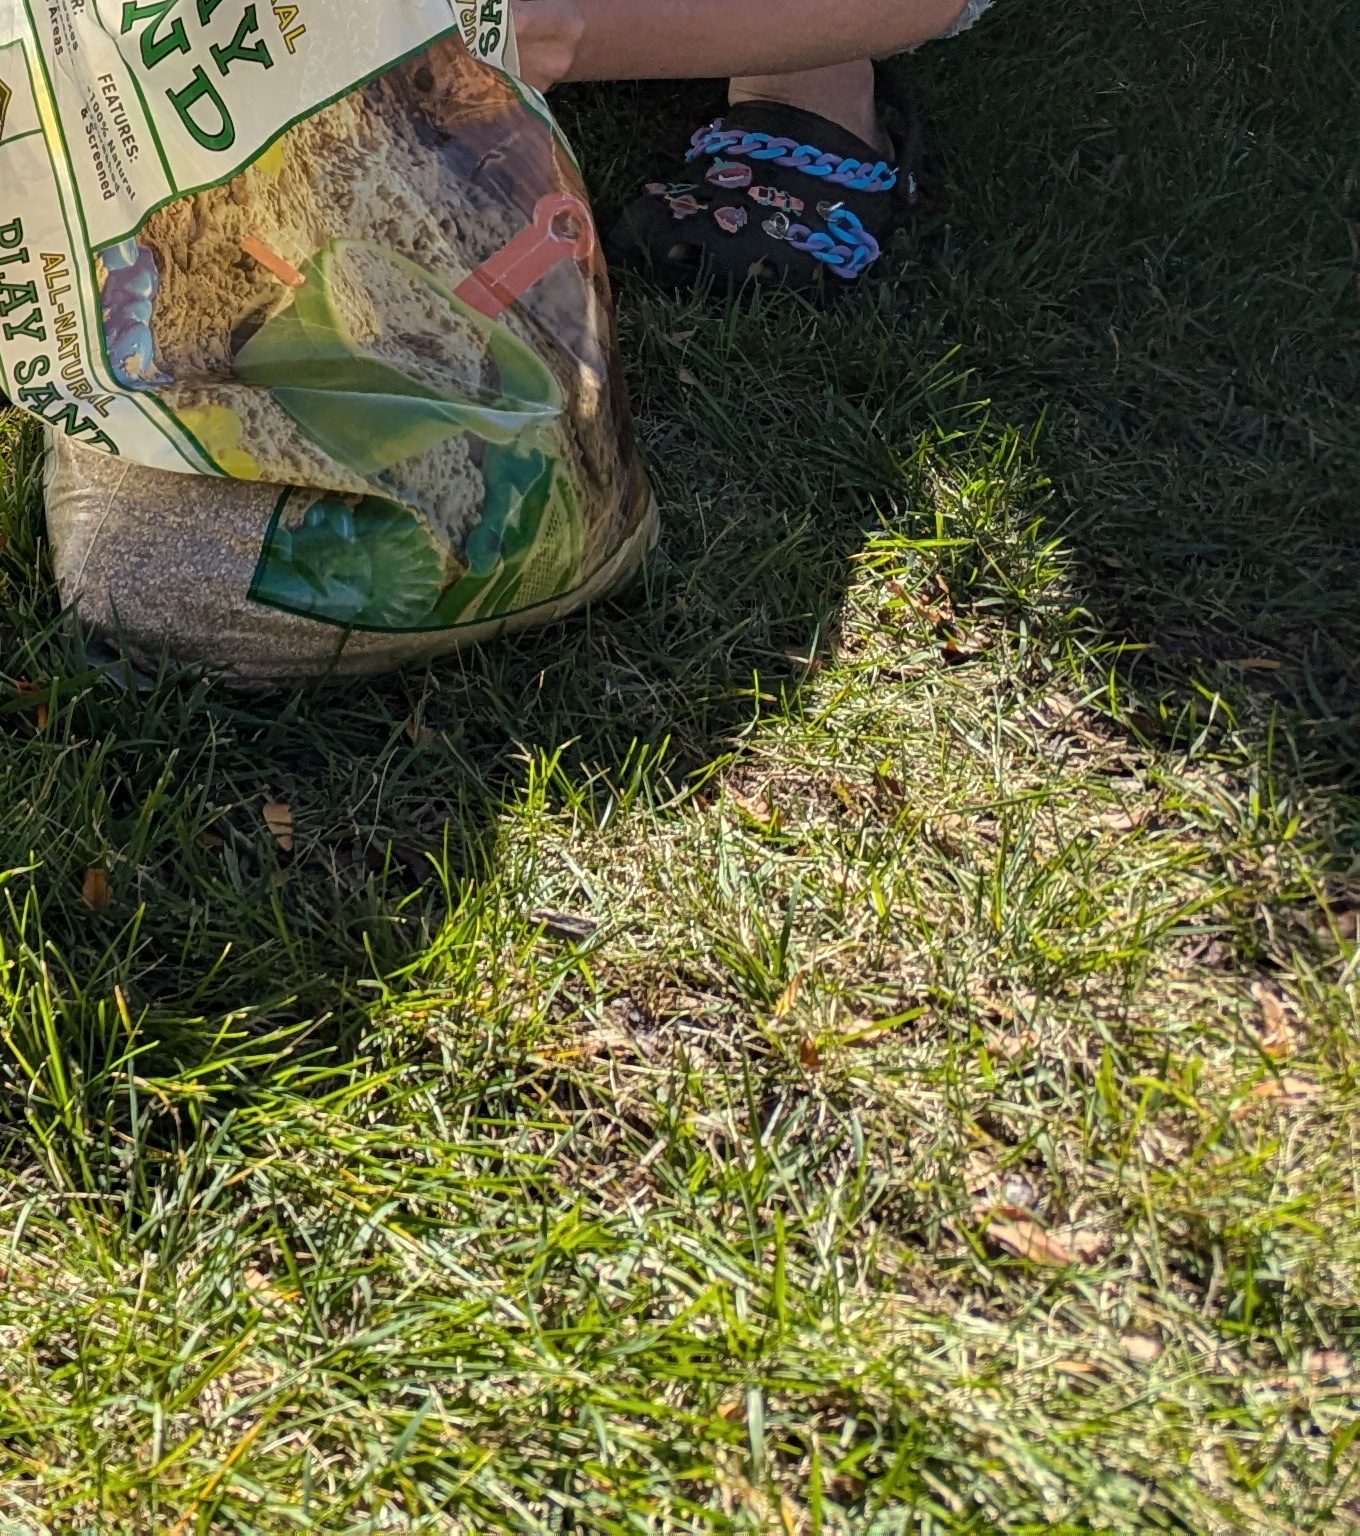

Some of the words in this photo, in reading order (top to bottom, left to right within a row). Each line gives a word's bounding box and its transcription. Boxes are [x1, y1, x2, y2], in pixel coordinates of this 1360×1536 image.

[48, 6, 64, 56] Areas
[80, 107, 89, 120] &
[85, 122, 116, 201] Screened
[97, 73, 138, 164] FEATURES:
[107, 139, 136, 202] Natural
[39, 251, 117, 419] ALL-NATURAL
[13, 354, 121, 457] SAND
